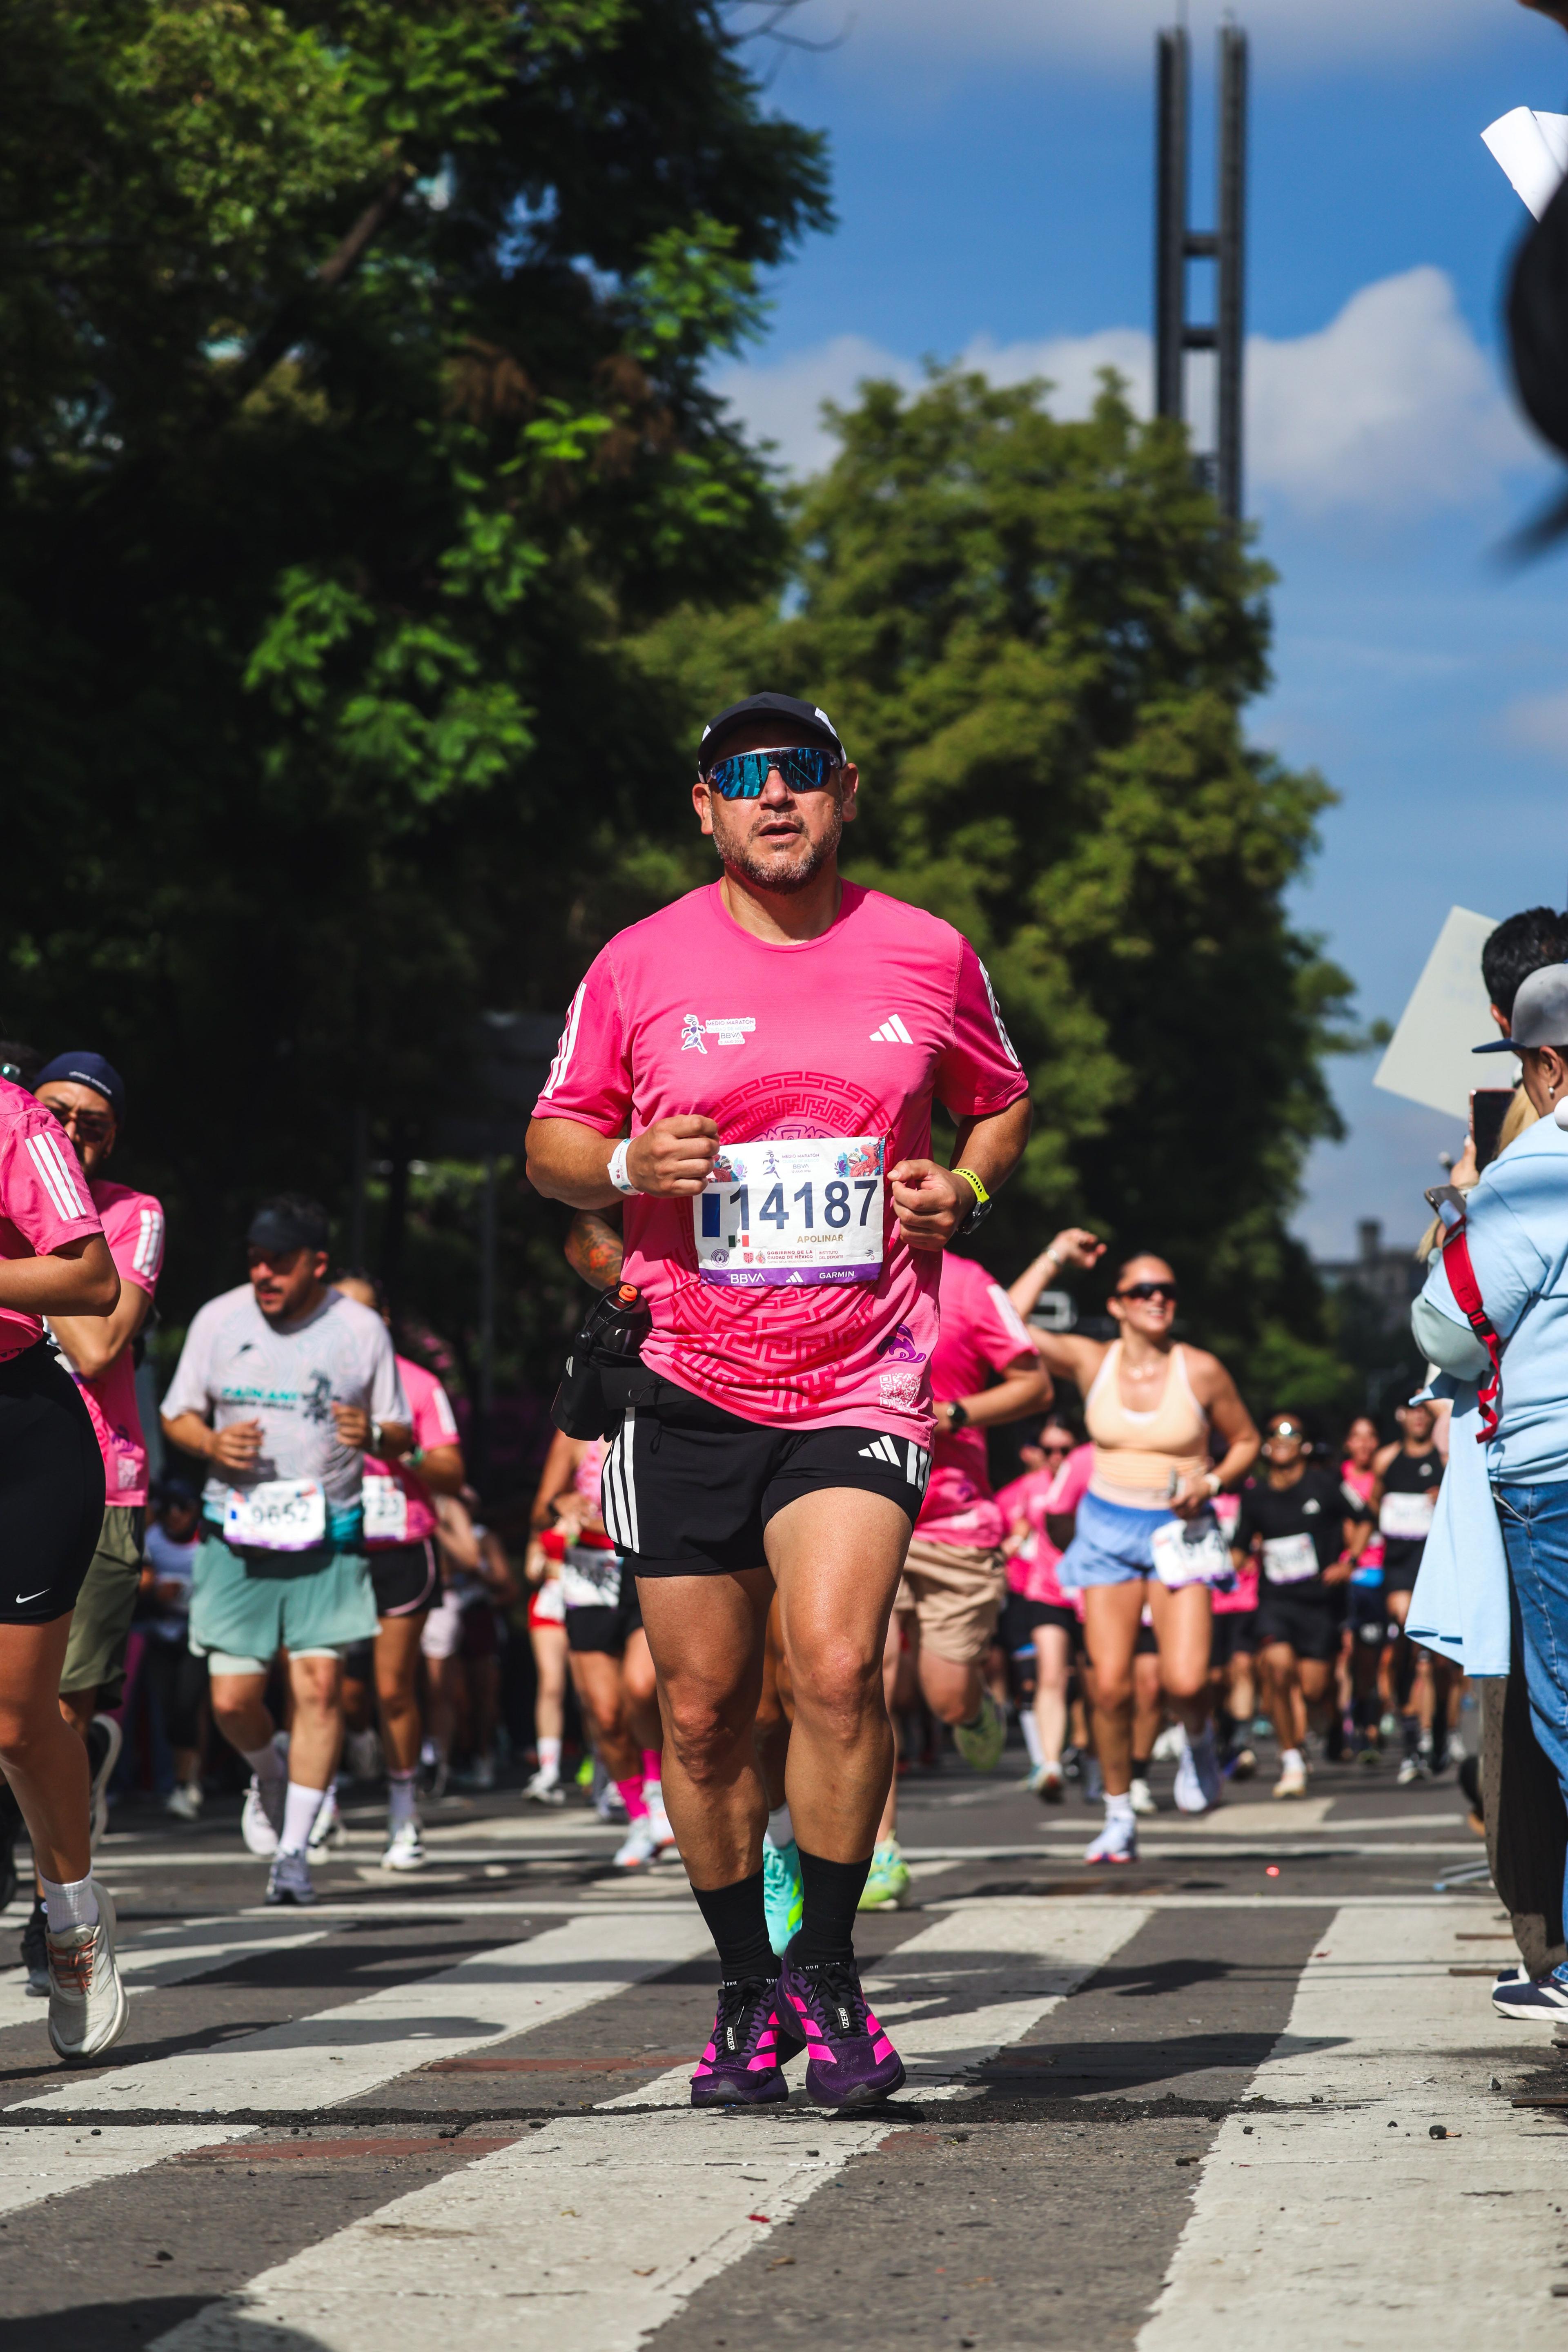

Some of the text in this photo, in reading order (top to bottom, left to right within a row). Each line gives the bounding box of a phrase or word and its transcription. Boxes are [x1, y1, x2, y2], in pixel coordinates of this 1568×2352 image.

[730, 1180, 878, 1230] 14187
[797, 1234, 844, 1243] APOLINAR
[731, 1272, 765, 1283] BBVA
[819, 1271, 855, 1279] GARMIN
